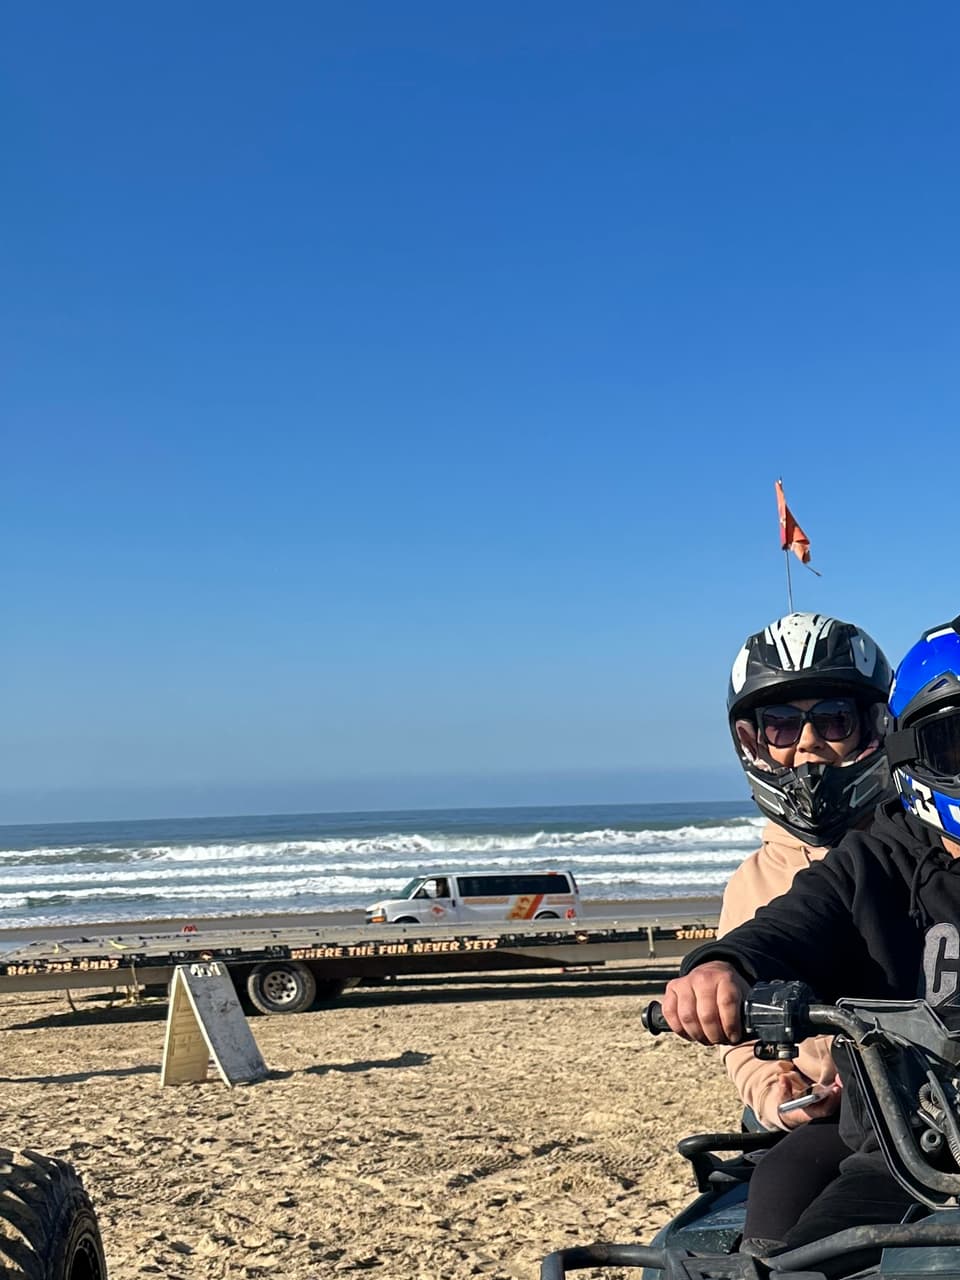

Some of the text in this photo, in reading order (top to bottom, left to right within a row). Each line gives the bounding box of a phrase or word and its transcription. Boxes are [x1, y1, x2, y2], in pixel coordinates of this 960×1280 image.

[675, 927, 718, 940] SUNB
[291, 938, 499, 960] WHERE THE FUN NEVER SETS
